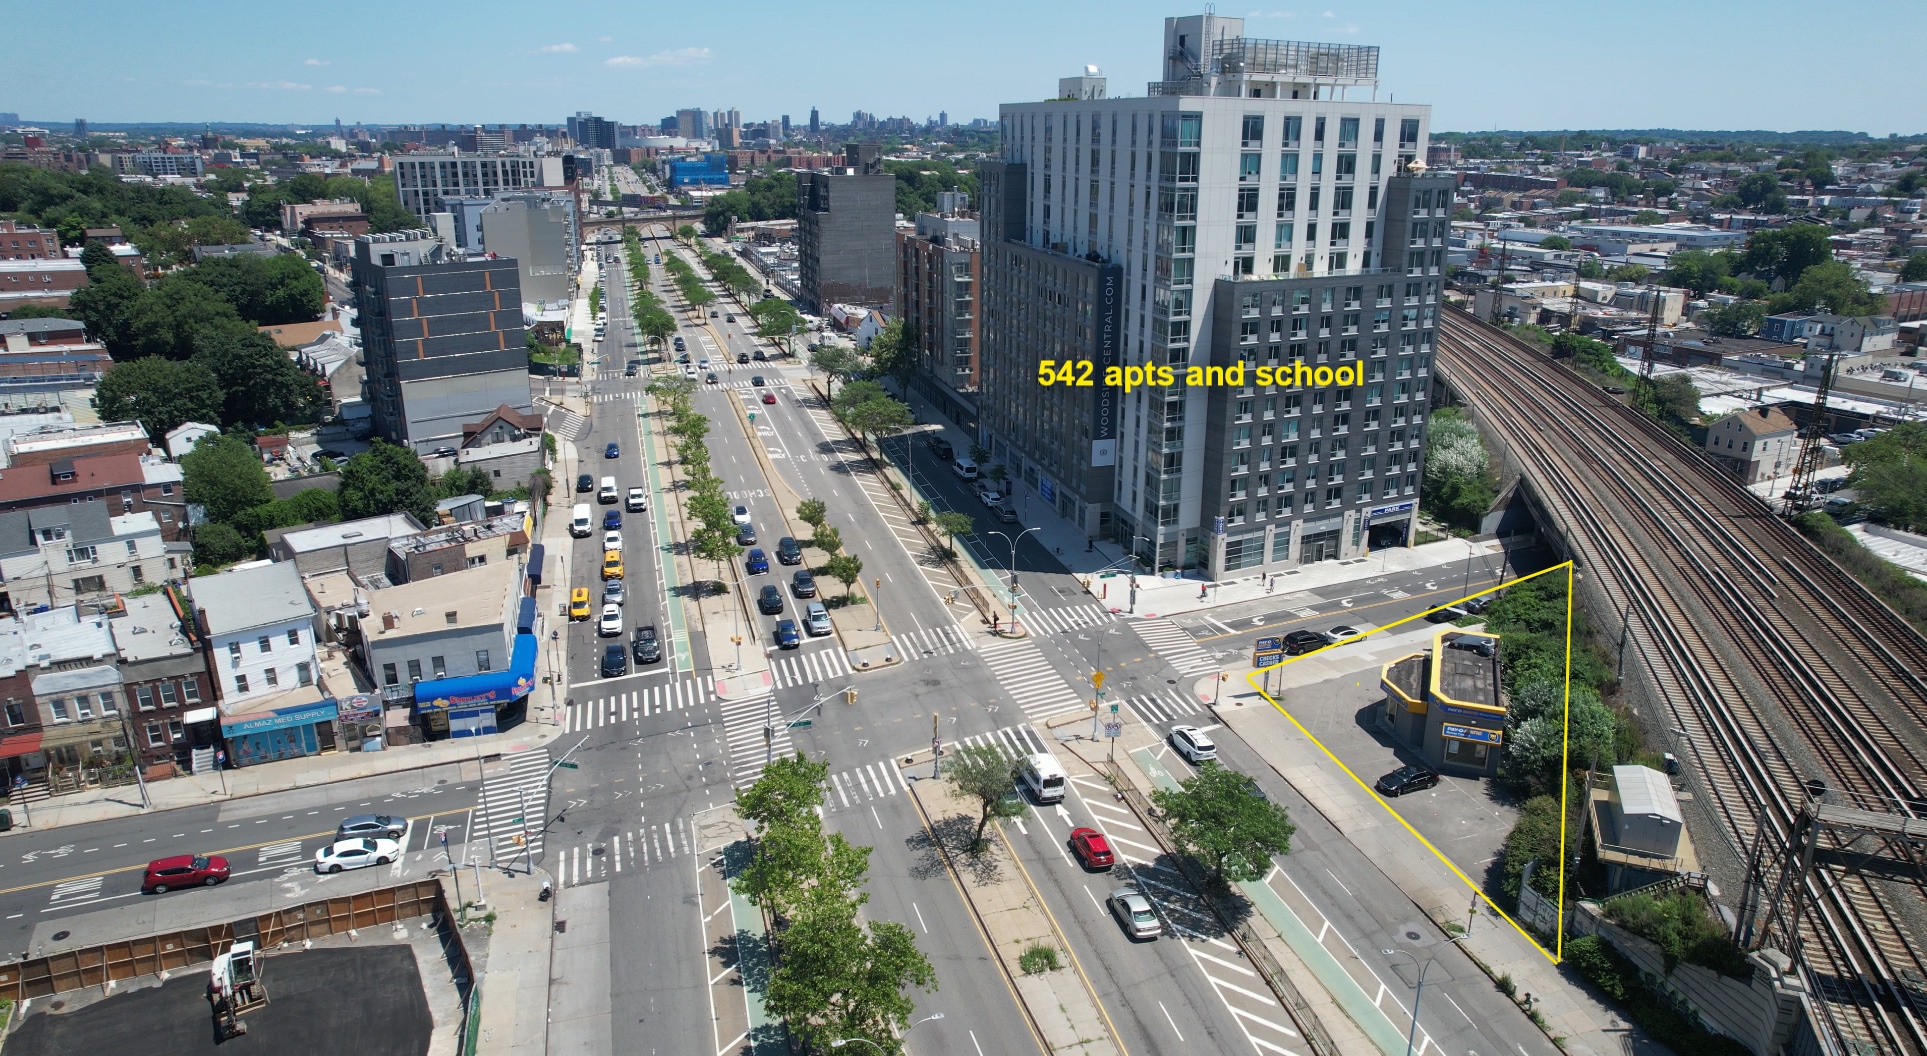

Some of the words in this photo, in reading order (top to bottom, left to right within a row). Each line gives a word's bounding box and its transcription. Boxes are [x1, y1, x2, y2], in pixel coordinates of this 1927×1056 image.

[1100, 276, 1114, 438] WOODSIE-CENTRAL.COM
[727, 489, 771, 500] SCHOOL
[1259, 654, 1280, 662] CHECKS
[242, 719, 273, 730] ALMAZ
[274, 715, 293, 725] MED
[294, 709, 326, 721] SUPPLY
